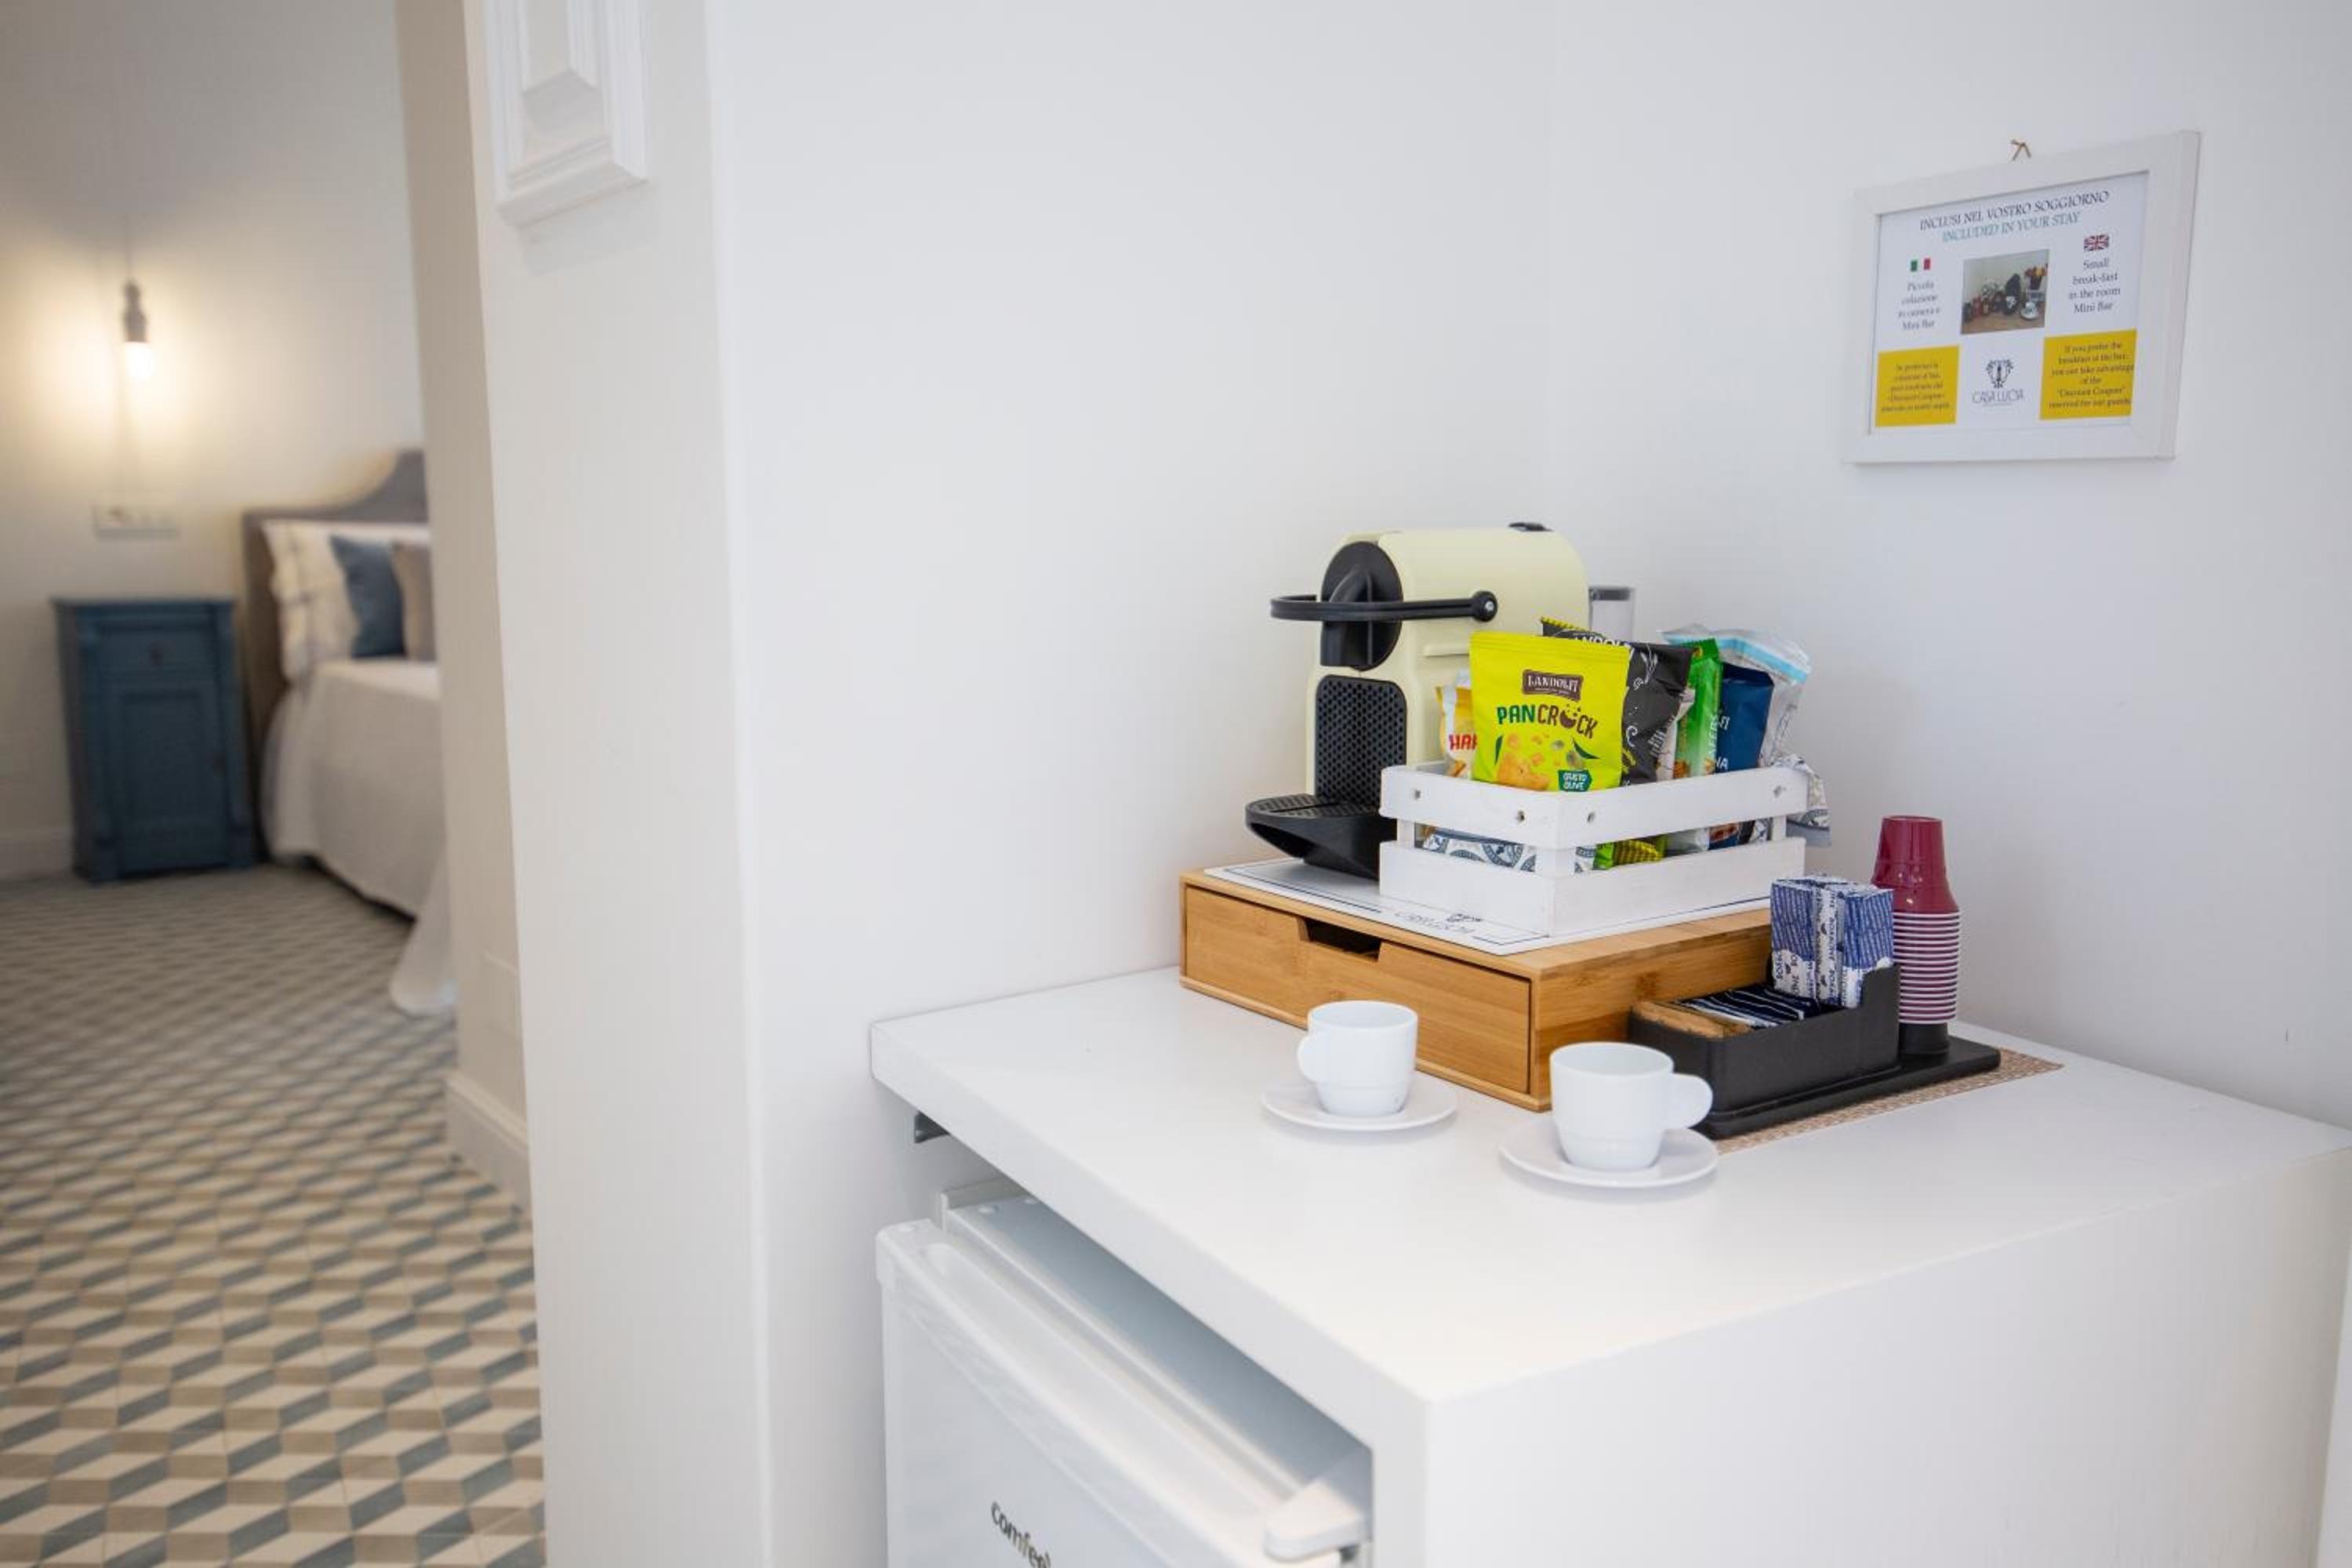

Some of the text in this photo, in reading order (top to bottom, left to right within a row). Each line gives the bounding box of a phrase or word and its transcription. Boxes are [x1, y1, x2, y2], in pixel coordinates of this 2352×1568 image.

[1919, 190, 2110, 231] INCLUSI NEL VOSTRO SOGGIORNO
[1943, 211, 2082, 242] INCLUDED IN YOUR STAY
[2083, 257, 2110, 270] Small
[2079, 288, 2094, 299] the
[2096, 288, 2121, 297] room
[2074, 302, 2096, 313] Mini
